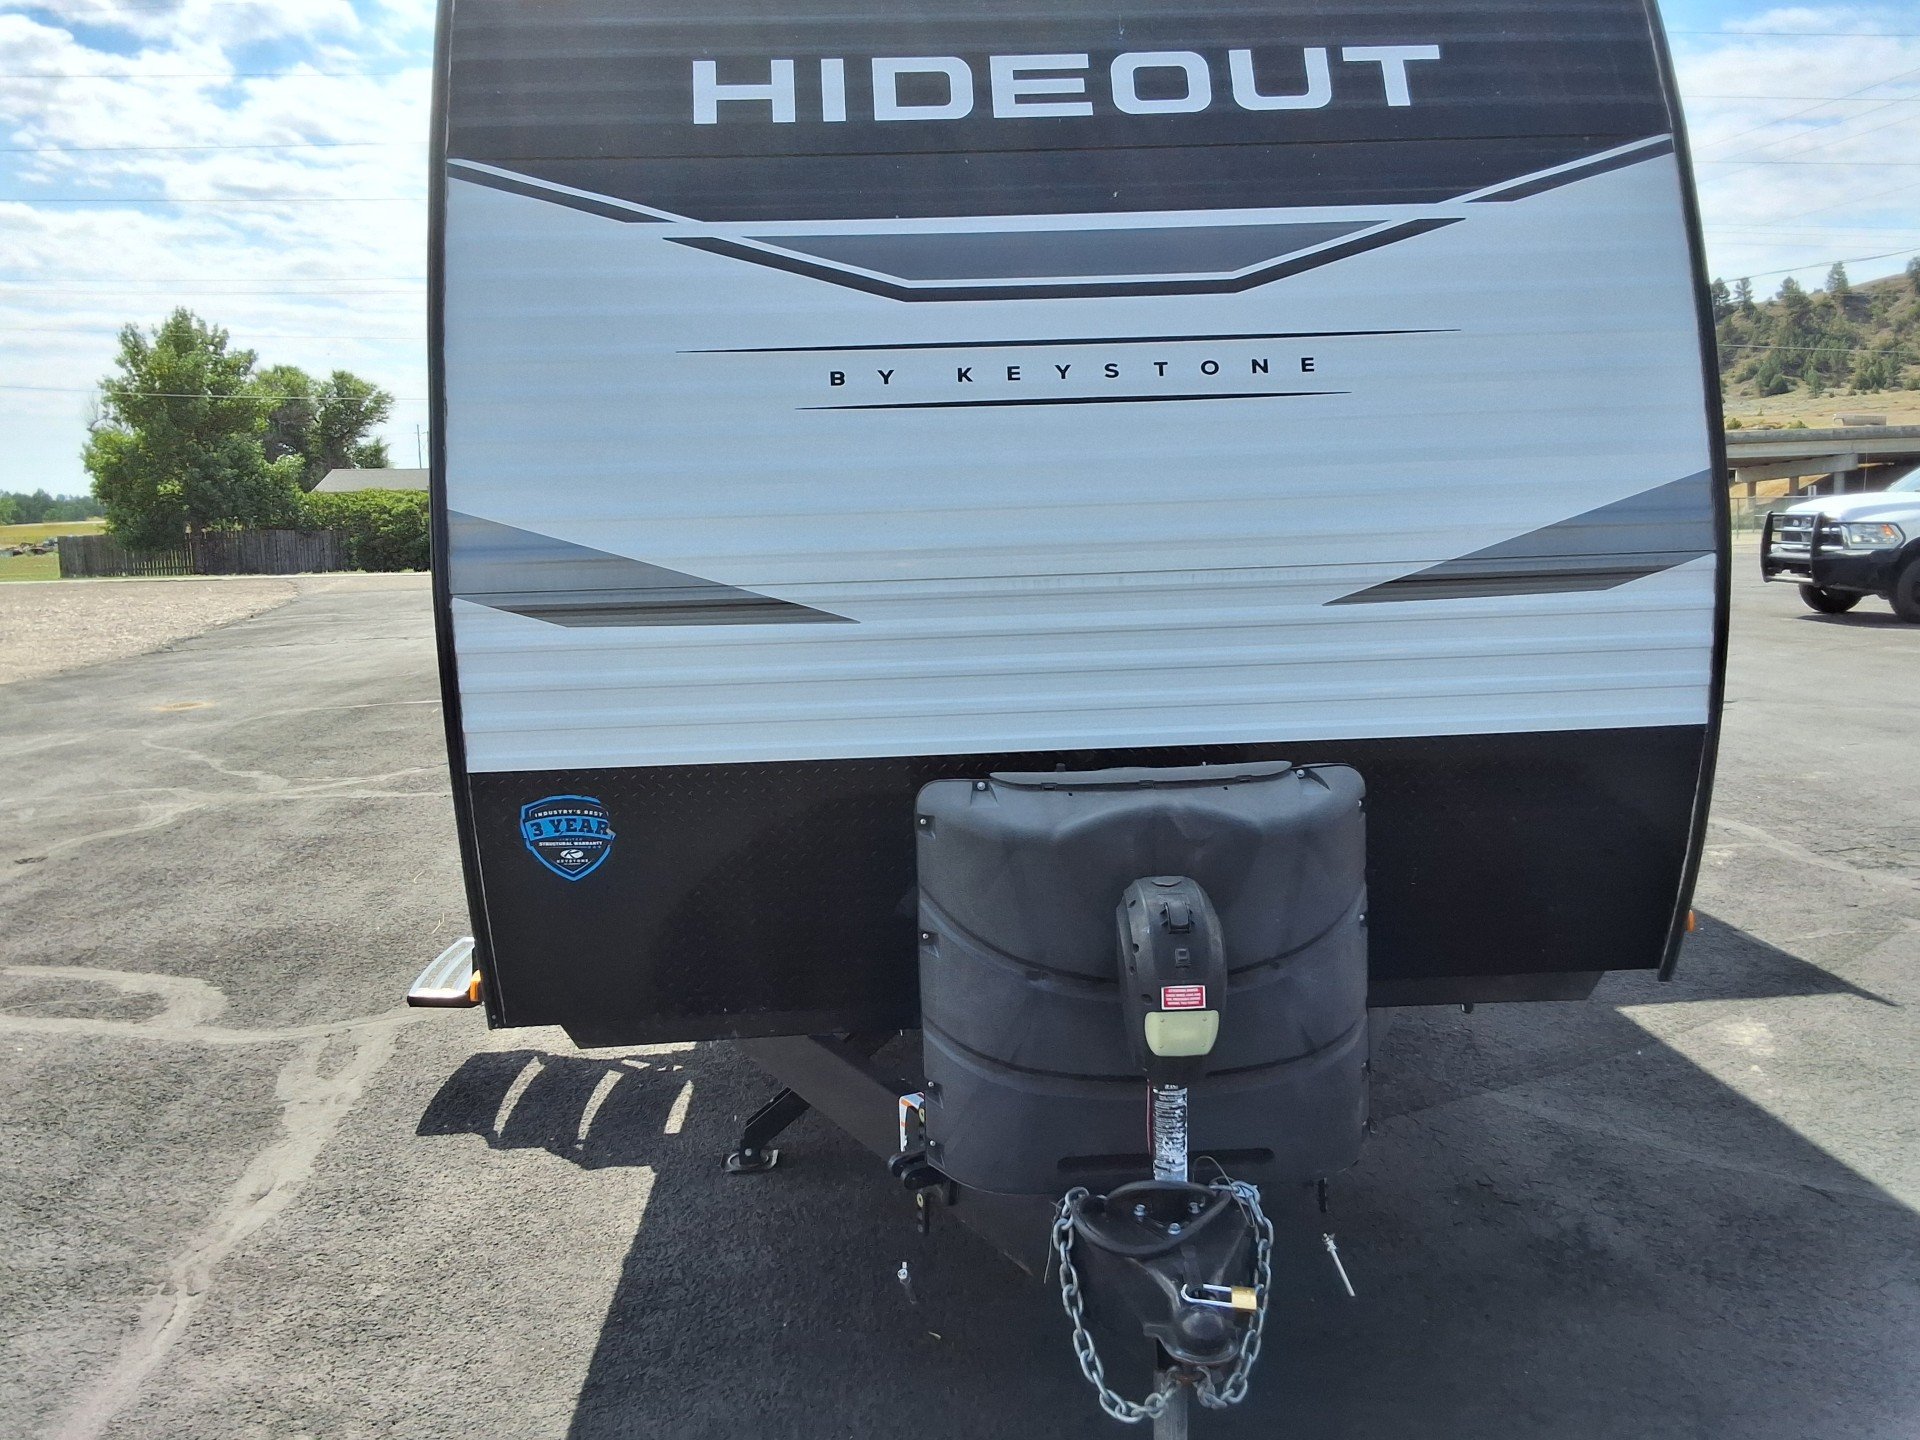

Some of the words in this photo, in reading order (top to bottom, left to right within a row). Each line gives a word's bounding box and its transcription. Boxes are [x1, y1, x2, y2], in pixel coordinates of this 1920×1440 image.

[692, 44, 1440, 124] HIDEOUT
[829, 368, 894, 388] BY
[956, 356, 1315, 384] KEYSTONE
[534, 809, 581, 818] INDUSTRY'S
[583, 809, 604, 818] BEST
[530, 821, 544, 837] 3
[549, 818, 609, 836] YEAR
